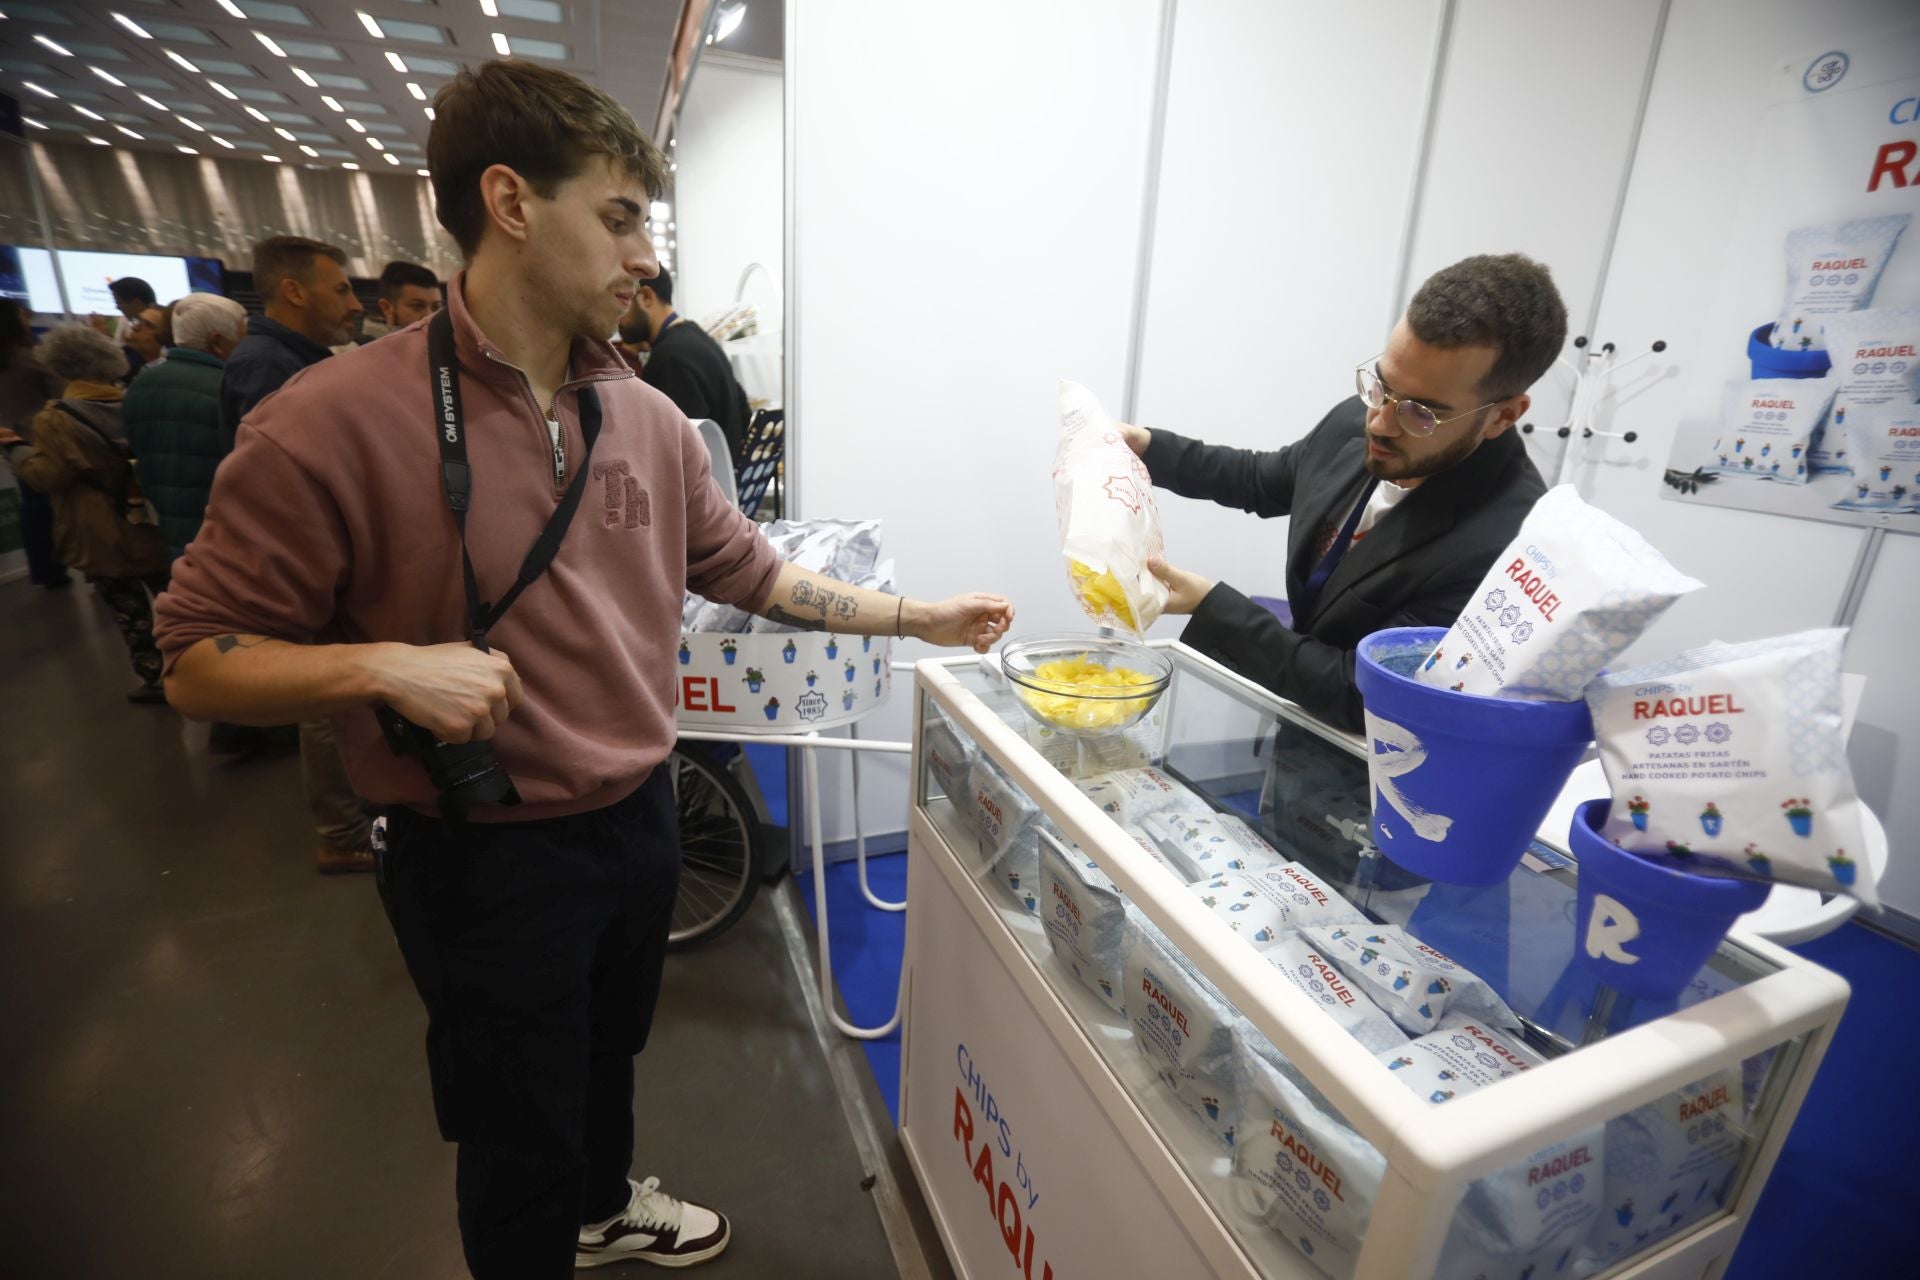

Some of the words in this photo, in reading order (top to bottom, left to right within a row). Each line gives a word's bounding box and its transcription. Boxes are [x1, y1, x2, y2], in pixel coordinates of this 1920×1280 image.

[1867, 140, 1920, 193] R
[1811, 258, 1868, 271] RAQUEL
[1855, 345, 1917, 359] RAQUEL
[440, 366, 455, 423] SYSTEM
[1751, 399, 1796, 410] RAQUEL
[446, 424, 458, 443] OM
[1526, 544, 1551, 573] CHIPS
[1505, 557, 1562, 624] RAQUEL
[675, 676, 736, 713] EL
[1633, 694, 1745, 720] RAQUEL
[1635, 683, 1676, 697] CHIPS
[1621, 773, 1646, 781] HAND
[1648, 771, 1689, 780] COOKED
[1691, 770, 1733, 779] POTATO
[1735, 769, 1768, 779] CHIPS
[1632, 761, 1690, 770] ARTESANAS
[1693, 761, 1707, 769] EN
[1709, 759, 1750, 769] SARTÉN
[1648, 752, 1692, 760] PATATAS
[1694, 750, 1731, 758] FRITAS
[1364, 708, 1455, 843] R
[1053, 882, 1082, 926] RAQUEL
[1281, 867, 1329, 907] RAQUEL
[1586, 894, 1641, 965] R
[1307, 954, 1356, 1008] RAQUEL
[1142, 977, 1190, 1039] RAQUEL
[957, 1043, 1011, 1158] CHIPS
[1016, 1151, 1039, 1211] by
[1270, 1119, 1345, 1203] RAQUEL
[1528, 1145, 1594, 1188] RAQUEL
